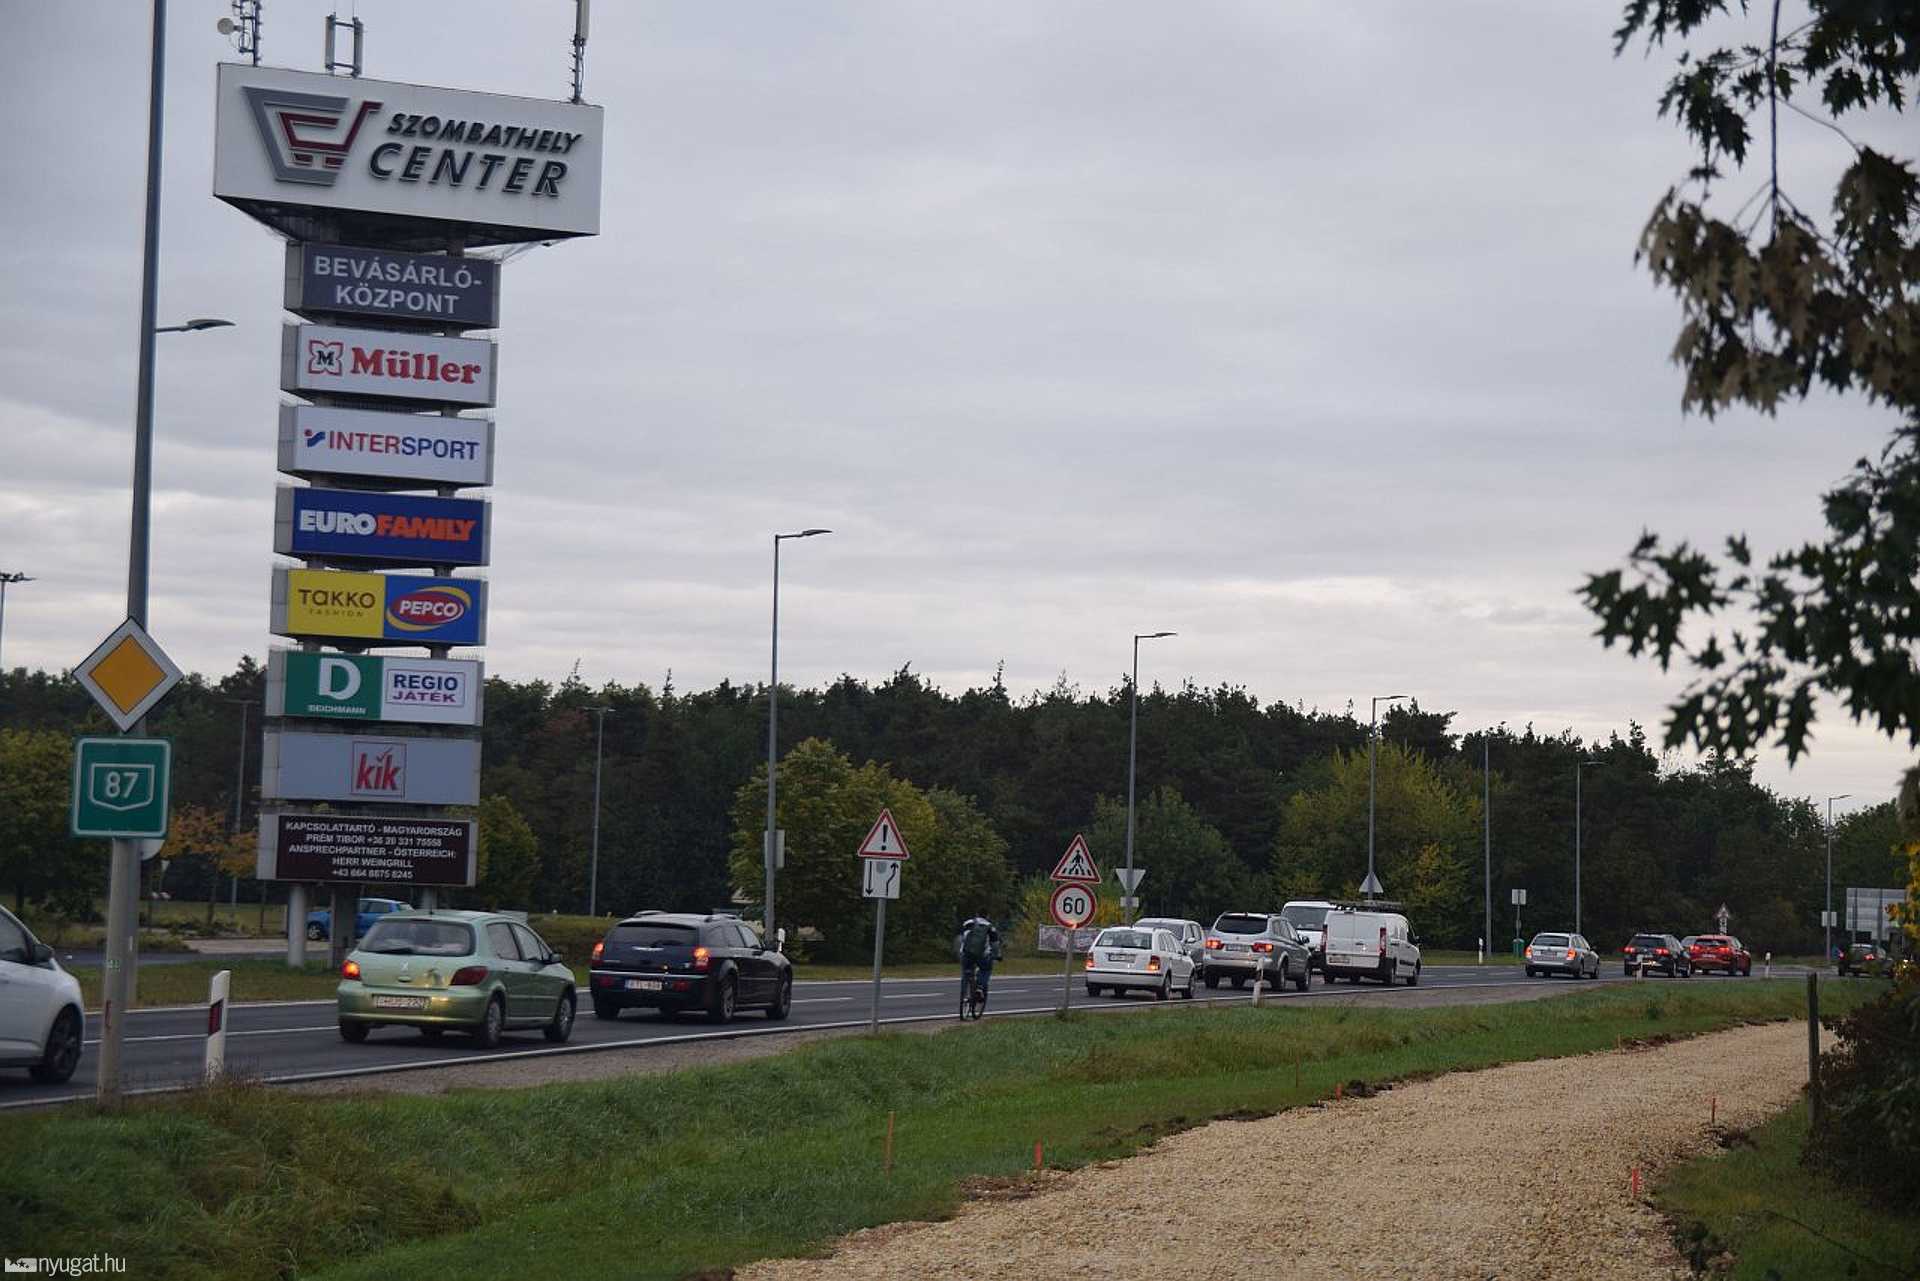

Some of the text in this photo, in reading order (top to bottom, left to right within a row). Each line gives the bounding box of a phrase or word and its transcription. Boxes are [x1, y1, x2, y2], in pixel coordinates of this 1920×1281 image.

[386, 113, 584, 154] SZOMBATHELY
[369, 142, 568, 197] CENTER
[314, 255, 484, 289] BEVÁSÁRLÓ-
[336, 282, 461, 314] KÖZPONT
[351, 346, 482, 384] Müller
[329, 430, 480, 461] INTERSPORT
[399, 599, 460, 618] PEPCO
[317, 657, 362, 701] D
[393, 673, 459, 692] REGIO
[105, 770, 139, 798] 87
[1063, 896, 1085, 915] 60
